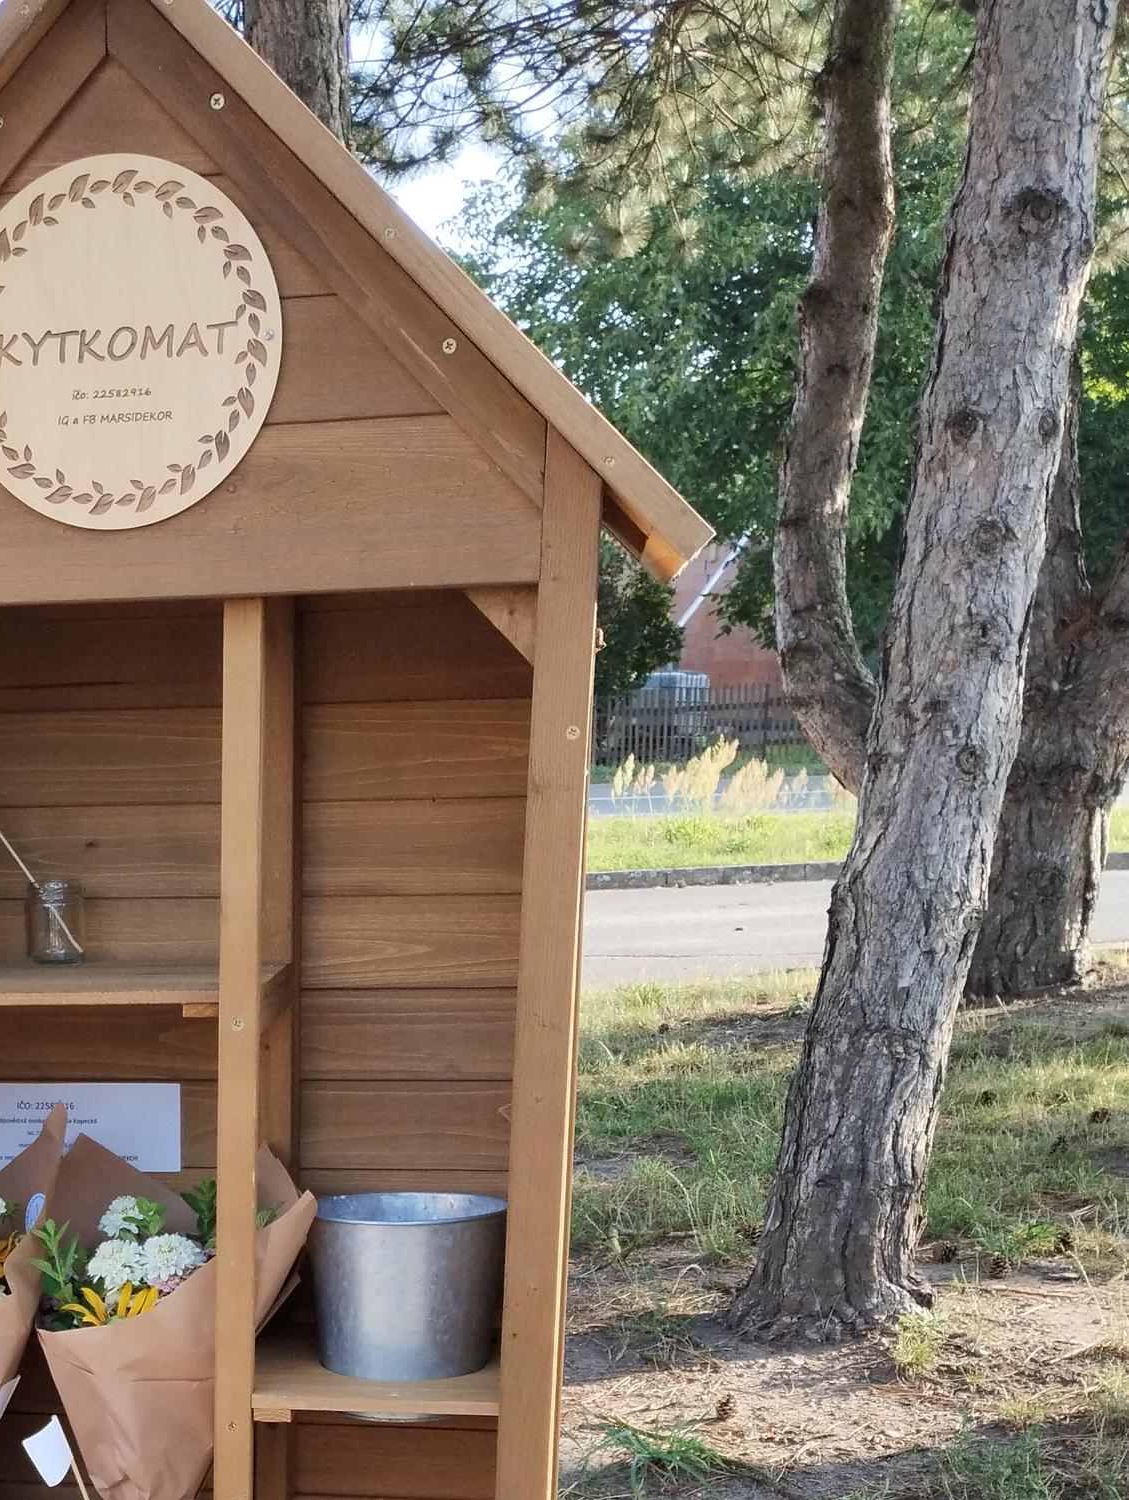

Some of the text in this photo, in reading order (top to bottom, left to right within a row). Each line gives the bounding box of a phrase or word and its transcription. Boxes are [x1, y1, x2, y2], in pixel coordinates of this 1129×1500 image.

[92, 387, 152, 399] 22582916
[72, 417, 79, 425] a
[83, 414, 96, 425] FB
[100, 410, 174, 424] MARSIDEKOR
[35, 1102, 75, 1110] 225816
